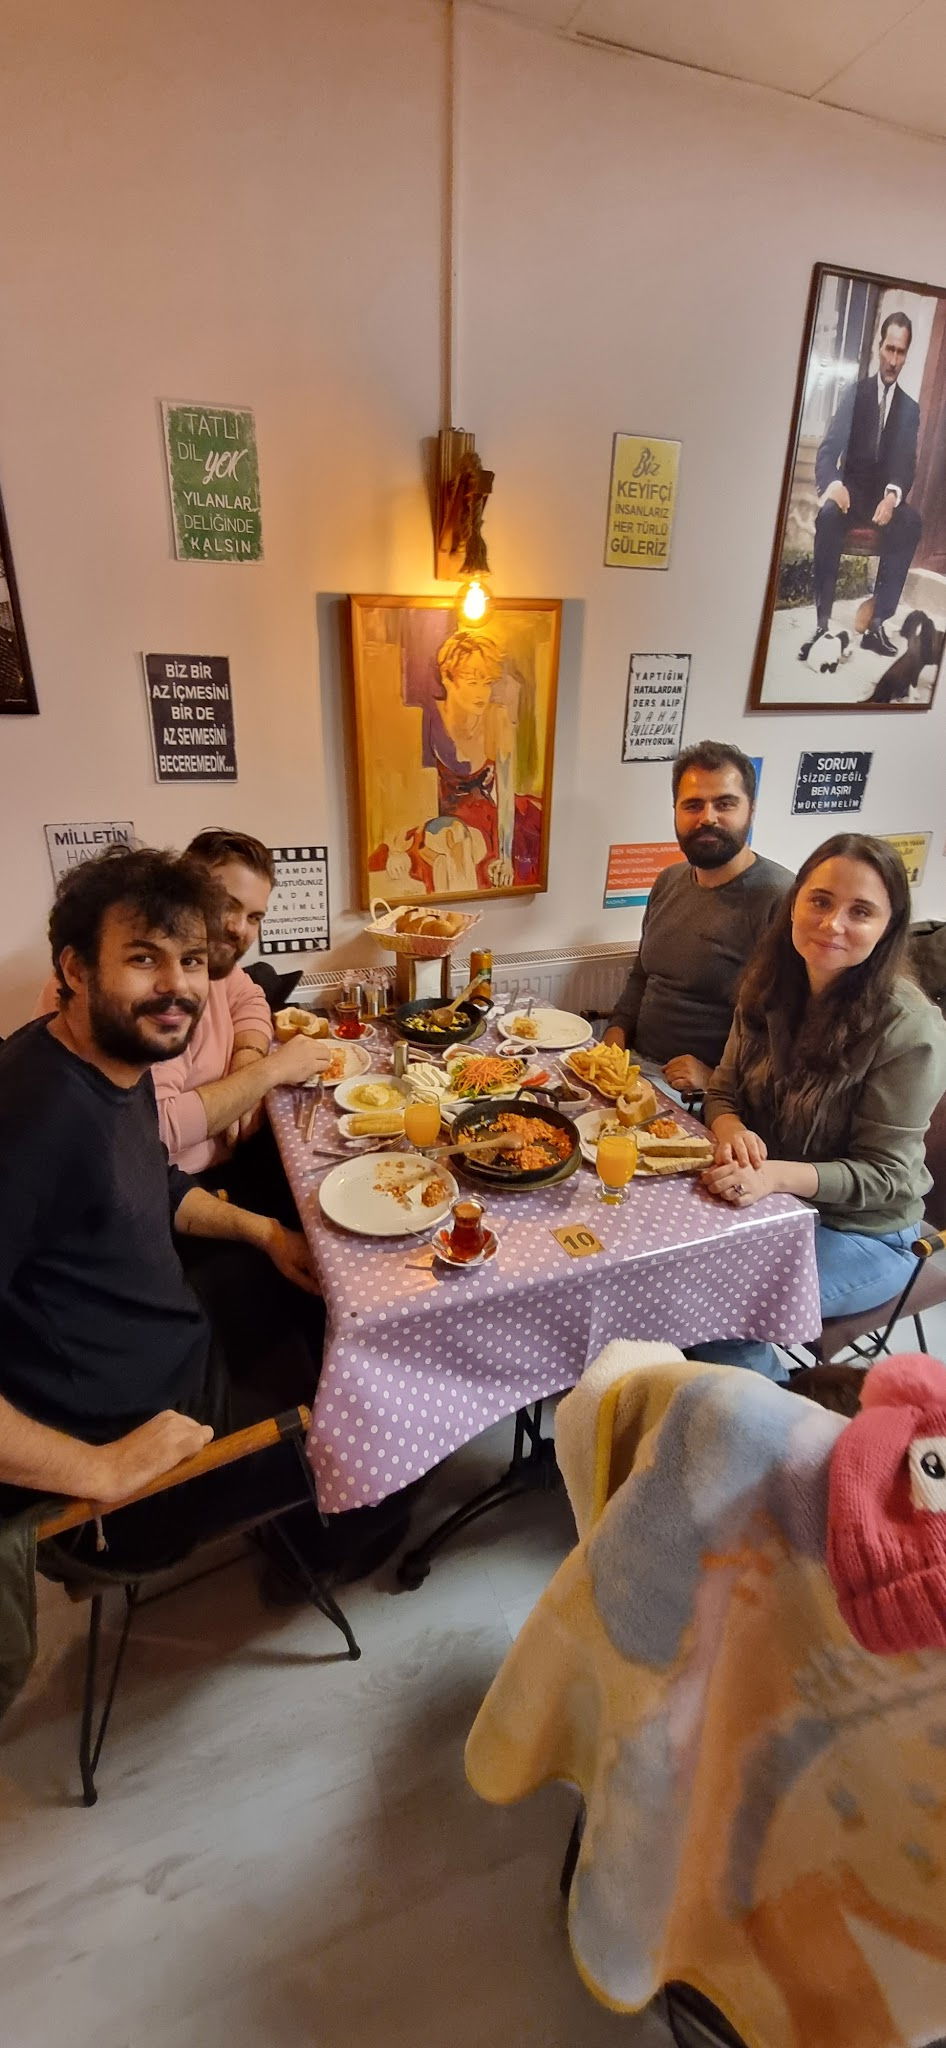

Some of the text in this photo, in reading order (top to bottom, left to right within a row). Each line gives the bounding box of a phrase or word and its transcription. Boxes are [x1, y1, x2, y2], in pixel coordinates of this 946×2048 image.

[184, 413, 239, 440] TATLI
[177, 440, 203, 462] DİL
[632, 447, 661, 478] Biz
[617, 479, 673, 503] KEYİFÇİ
[183, 491, 251, 511] YILANLAR
[615, 503, 670, 519] İNSANLARIZ
[184, 513, 254, 534] DELİĞİNDE
[613, 520, 668, 536] HER TÜRLÜ
[191, 537, 251, 553] KALSIN
[610, 536, 667, 557] GÜLERİZ
[165, 660, 213, 679] BİZ BİR
[635, 669, 684, 681] YAPTIĞIM
[152, 682, 230, 702] AZ İÇMESİNİ
[633, 685, 682, 695] HATALARDAN
[171, 703, 215, 720] BİR DE
[632, 699, 680, 708] DERS ALIP
[632, 710, 678, 723] DAHA
[163, 723, 227, 745] AZ SEVMESİNİ
[816, 757, 858, 771] SORUN
[801, 771, 864, 783] SİZDE DEĞİL
[810, 785, 852, 798] BEN AŞIRI
[797, 799, 860, 810] MÜKEMMELİM
[54, 828, 129, 846] MİLLETİN
[66, 849, 98, 865] HAY
[276, 867, 323, 875] KAMDAN
[277, 890, 324, 899] ADAR
[272, 902, 325, 912] ENİMLE
[563, 1232, 595, 1250] 10
